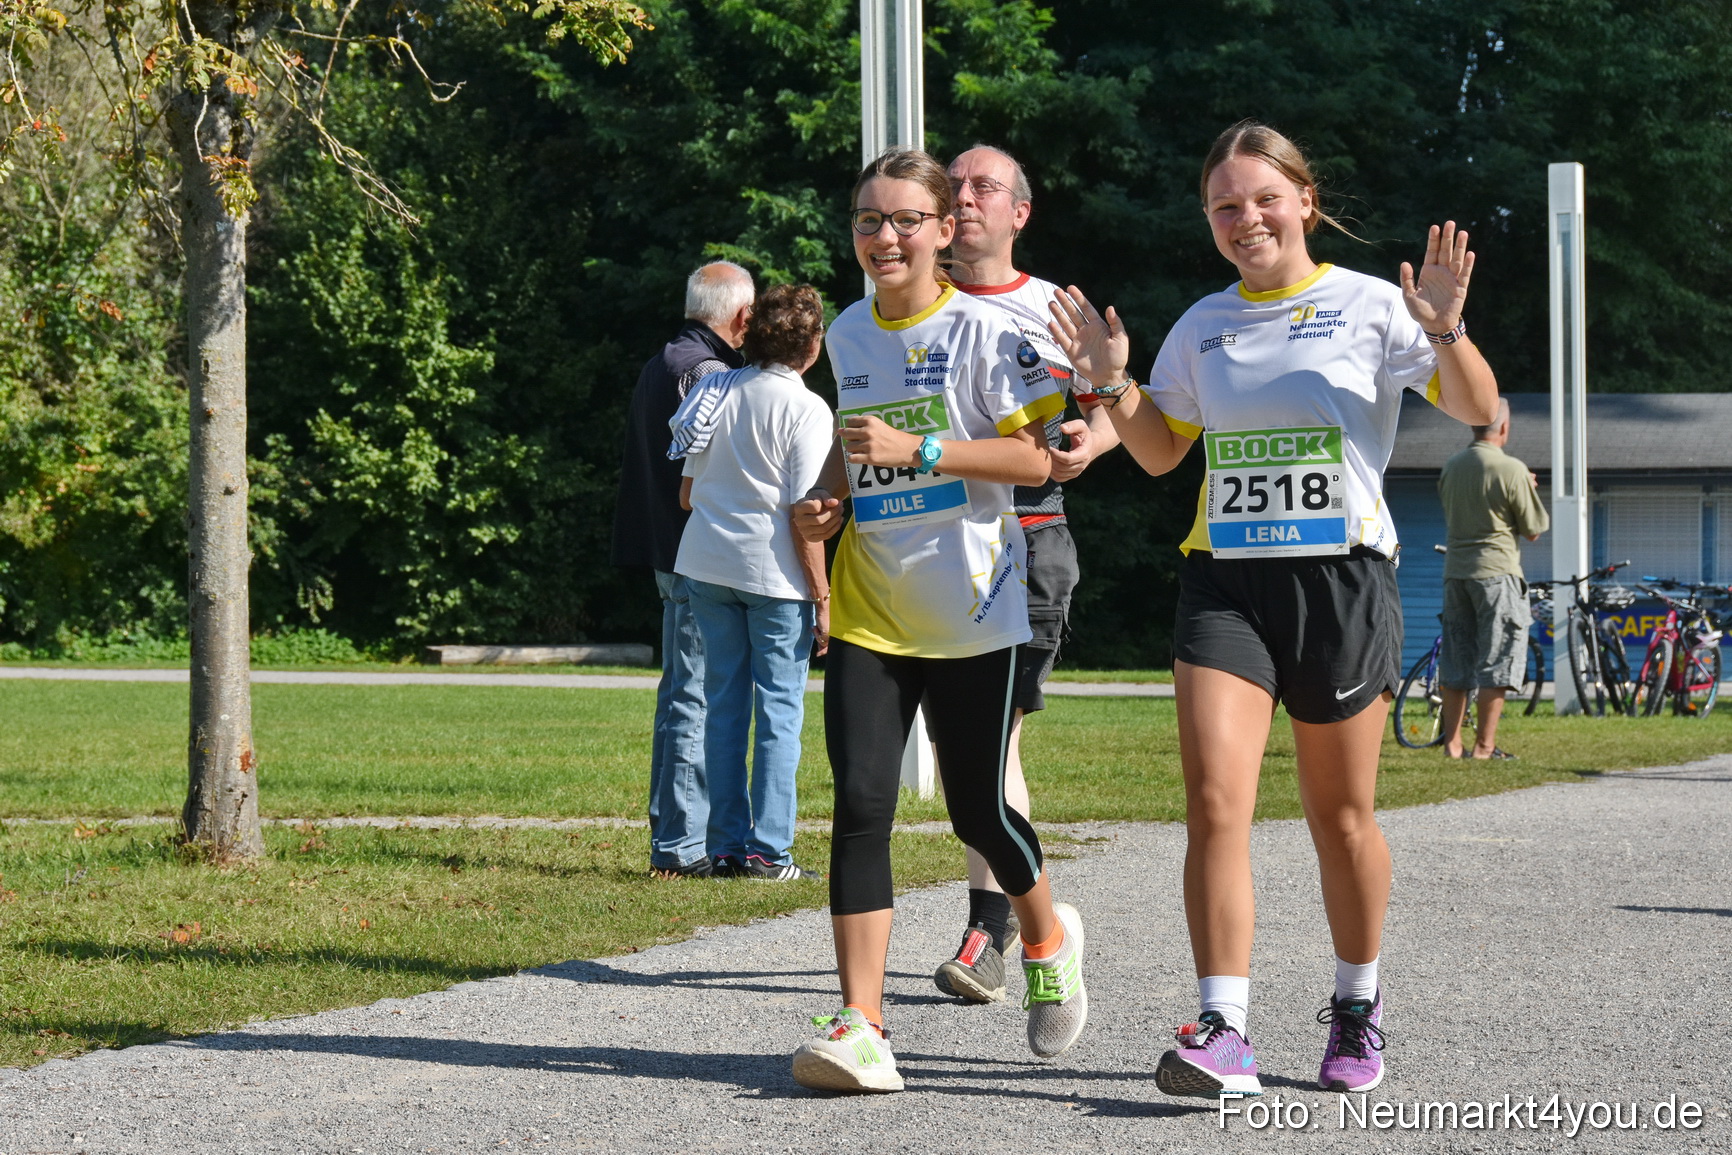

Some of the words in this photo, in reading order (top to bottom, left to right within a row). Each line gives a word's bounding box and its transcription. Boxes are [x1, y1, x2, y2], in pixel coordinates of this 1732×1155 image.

[1291, 306, 1315, 322] 20
[1289, 319, 1347, 332] Neumarkter
[906, 348, 928, 364] 20
[904, 377, 945, 387] Stadtlau
[1021, 367, 1050, 380] PARTL
[1215, 431, 1332, 465] BOCK
[1222, 472, 1330, 514] 2518
[1332, 474, 1340, 482] D
[879, 494, 925, 515] JULE
[1245, 525, 1302, 543] LENA
[974, 600, 993, 624] 14./15.
[989, 561, 1013, 599] Septemb
